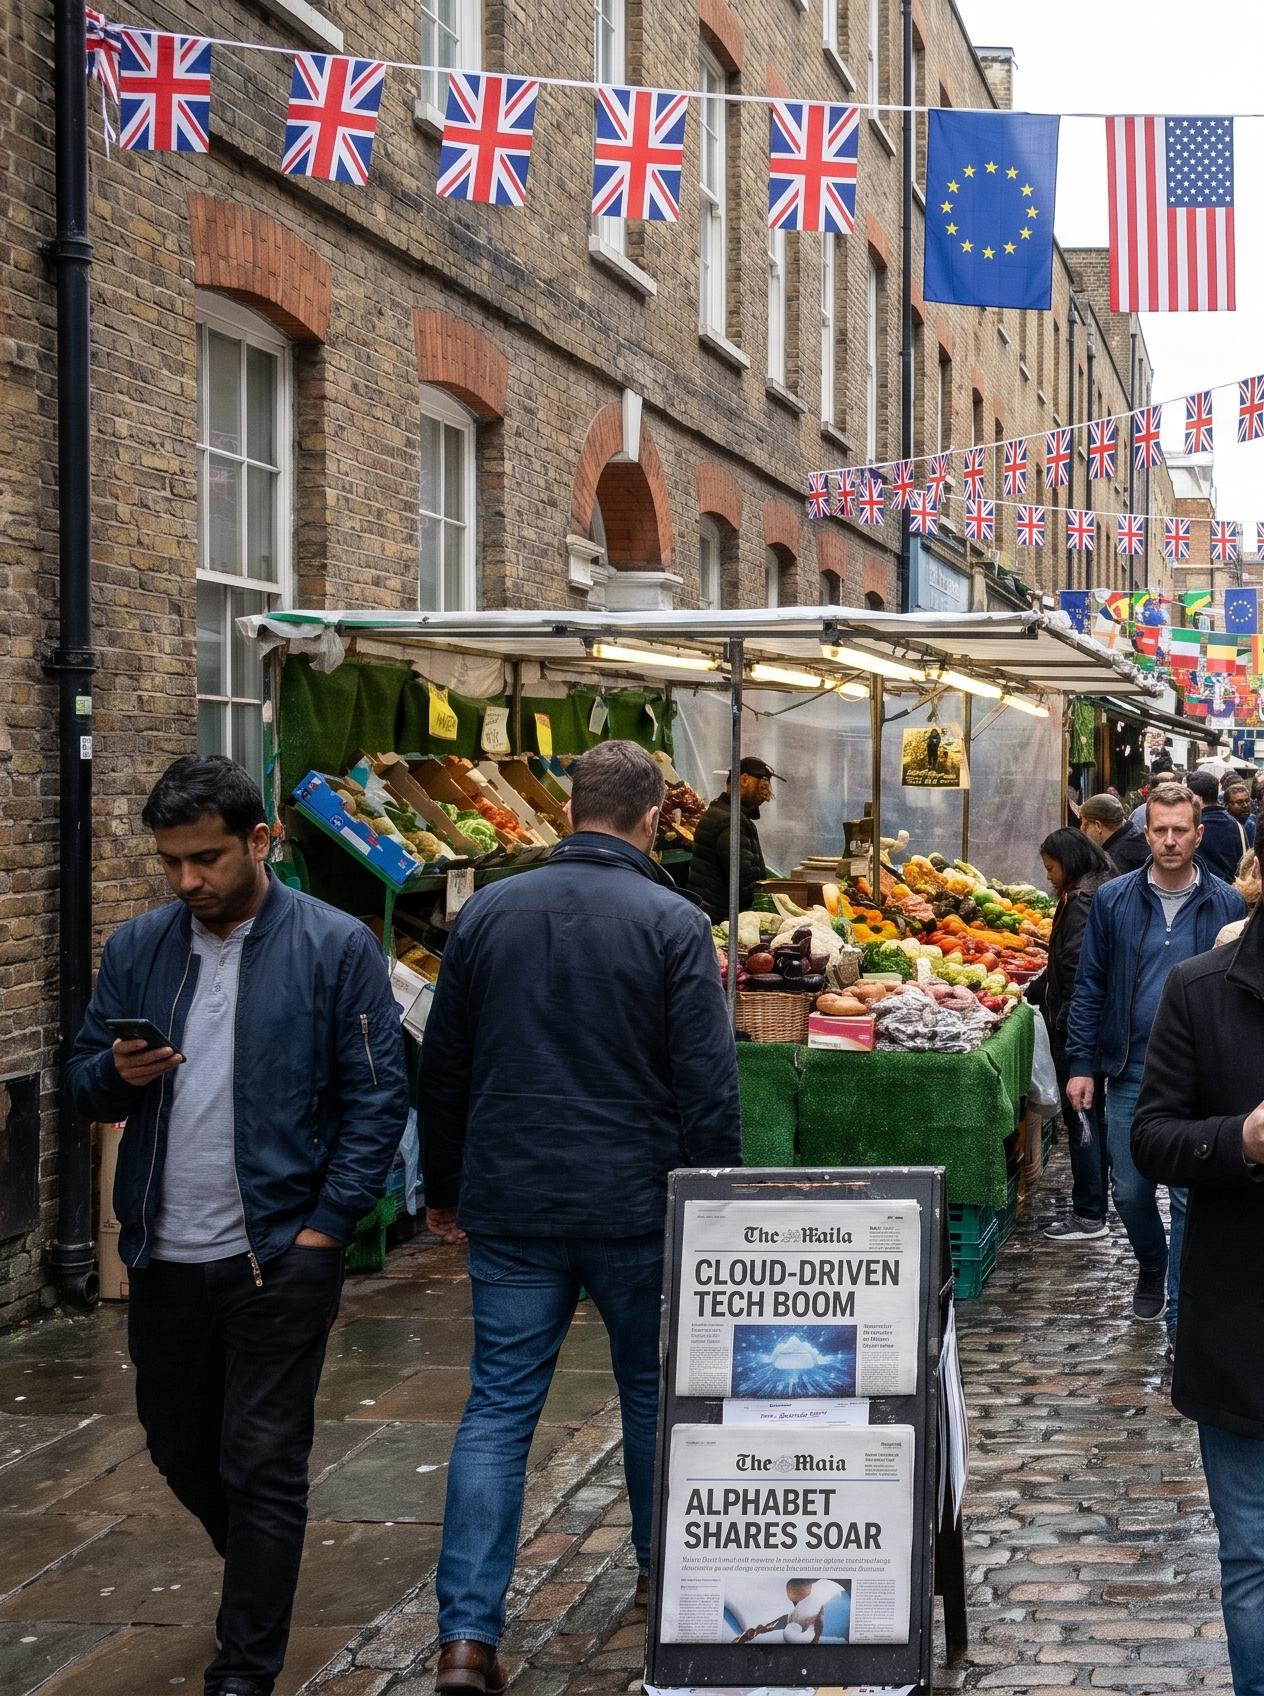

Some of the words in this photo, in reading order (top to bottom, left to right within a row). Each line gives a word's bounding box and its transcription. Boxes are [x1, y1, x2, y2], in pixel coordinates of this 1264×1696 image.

[743, 1226, 780, 1244] The
[694, 1258, 900, 1287] CLOUD-DRIVEN
[693, 1290, 764, 1318] TECH
[772, 1290, 856, 1318] BOOM
[735, 1453, 773, 1472] The
[685, 1488, 836, 1516] ALPHABET
[684, 1521, 798, 1550] SHARES
[805, 1521, 882, 1550] SOAR
